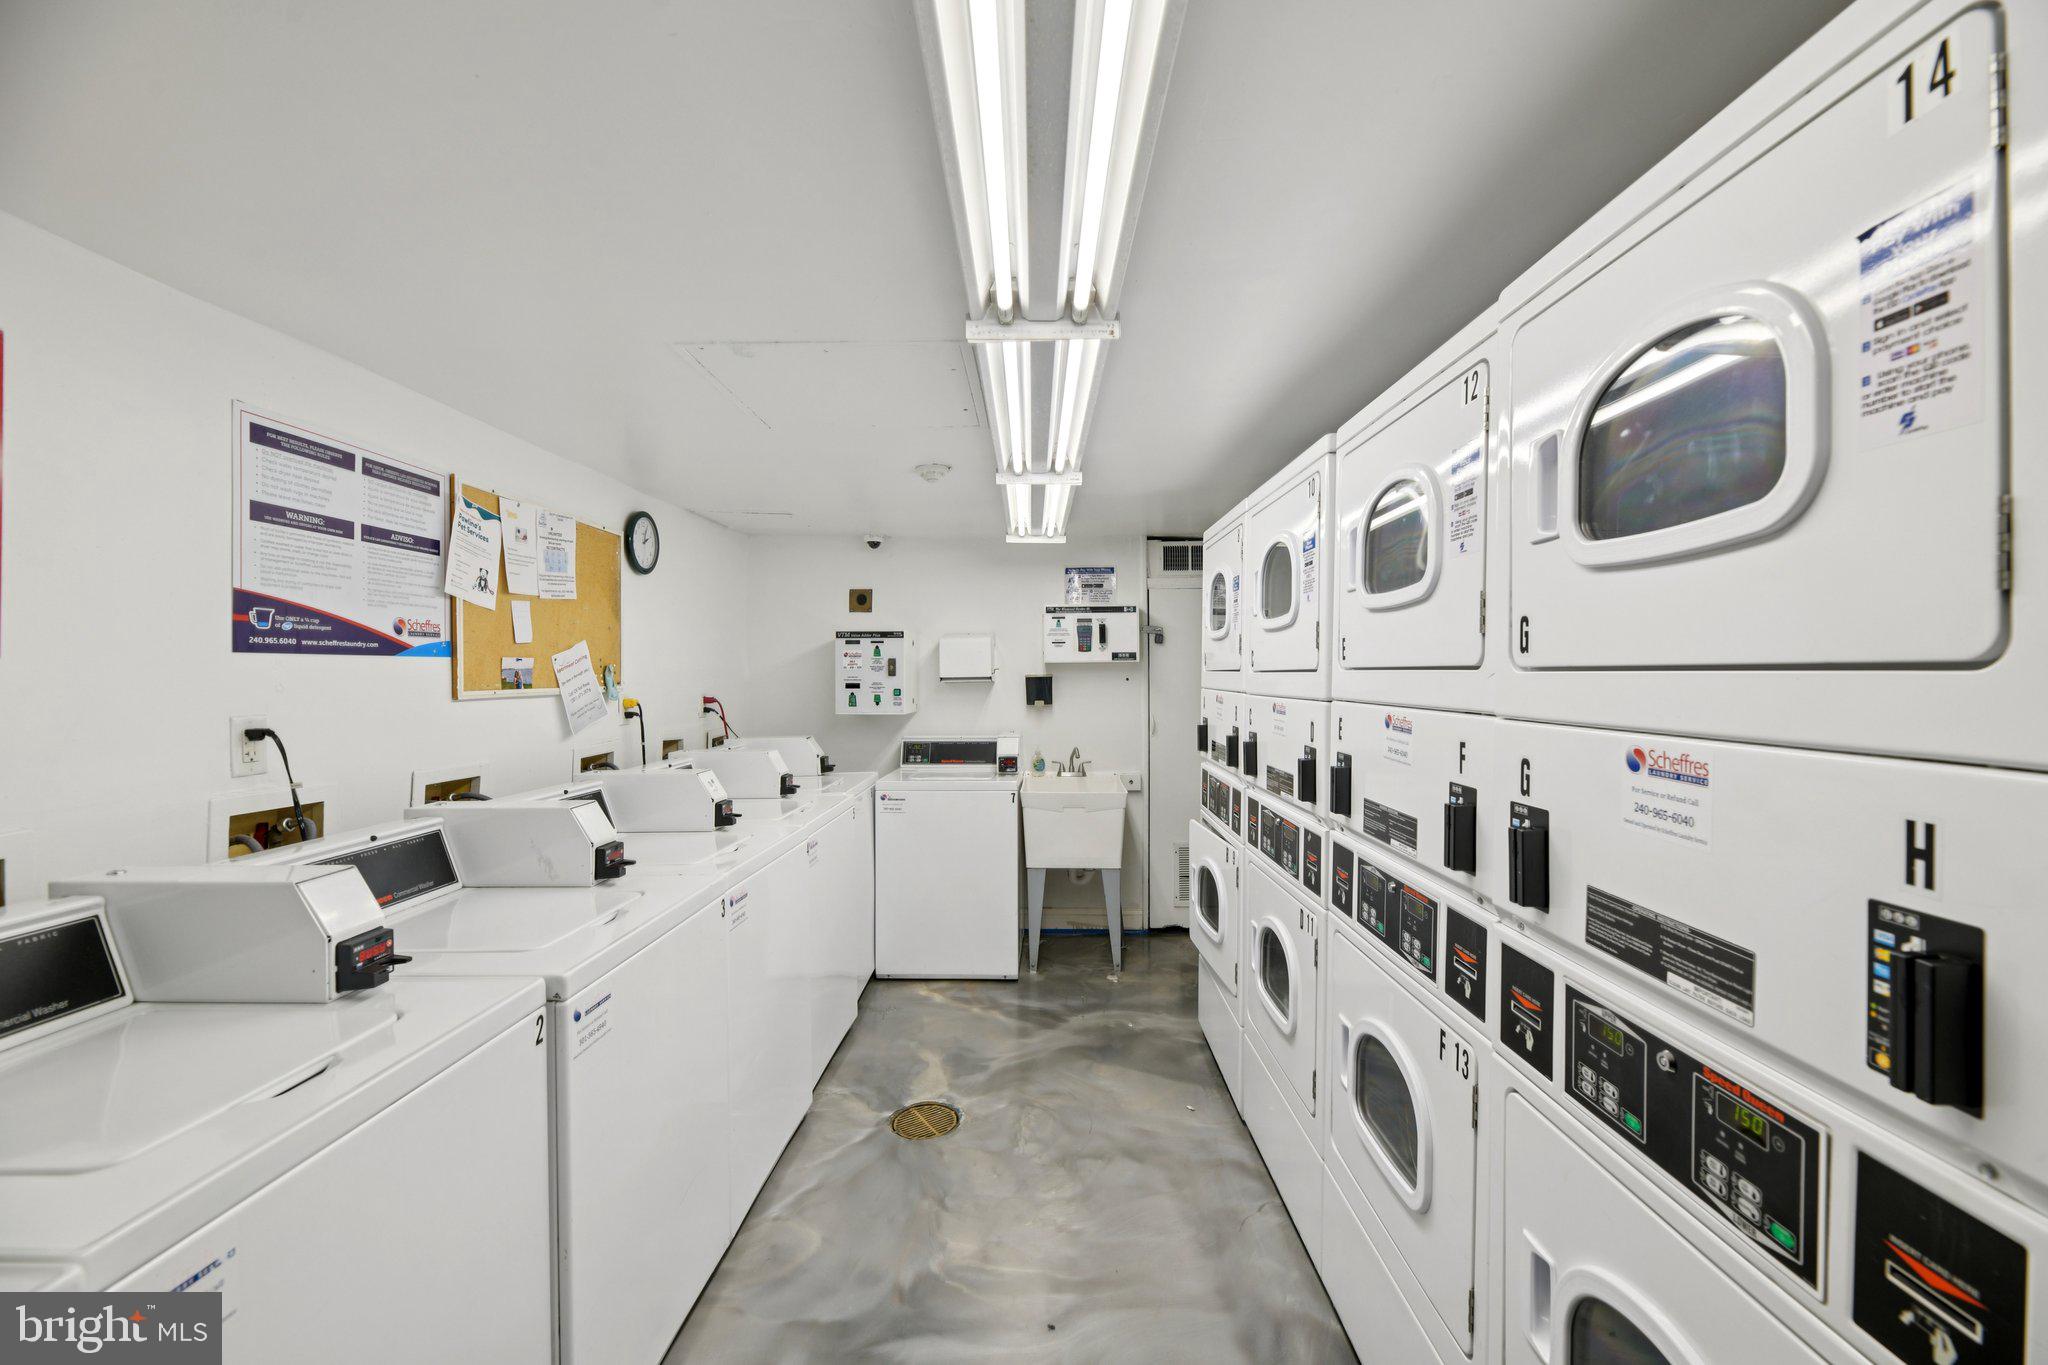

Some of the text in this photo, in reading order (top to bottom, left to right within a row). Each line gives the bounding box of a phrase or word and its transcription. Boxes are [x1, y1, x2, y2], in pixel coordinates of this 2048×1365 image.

[1896, 37, 1957, 125] 14
[1463, 369, 1479, 405] 12
[285, 511, 326, 526] WARNING:
[467, 526, 489, 543] Services
[408, 618, 441, 632] Scheffres
[1519, 615, 1530, 654] G
[248, 636, 379, 648] 240.965.6040 www.scheffreslaundry.com
[1459, 742, 1466, 774] F
[1648, 749, 1709, 779] Scheffres
[1520, 758, 1531, 797] G
[1648, 769, 1709, 786] LAUNDRY SERVICE
[1010, 793, 1016, 803] 7
[1634, 802, 1695, 828] 240-965-6040
[1905, 818, 1936, 892] H
[720, 898, 726, 918] 3
[17, 931, 59, 946] FABRIC
[1306, 913, 1314, 937] 11
[32, 999, 69, 1017] Washer
[535, 1014, 544, 1046] 2
[1439, 1028, 1469, 1080] F 13
[1702, 1066, 1785, 1124] Speed Queen
[1734, 1103, 1763, 1136] 150
